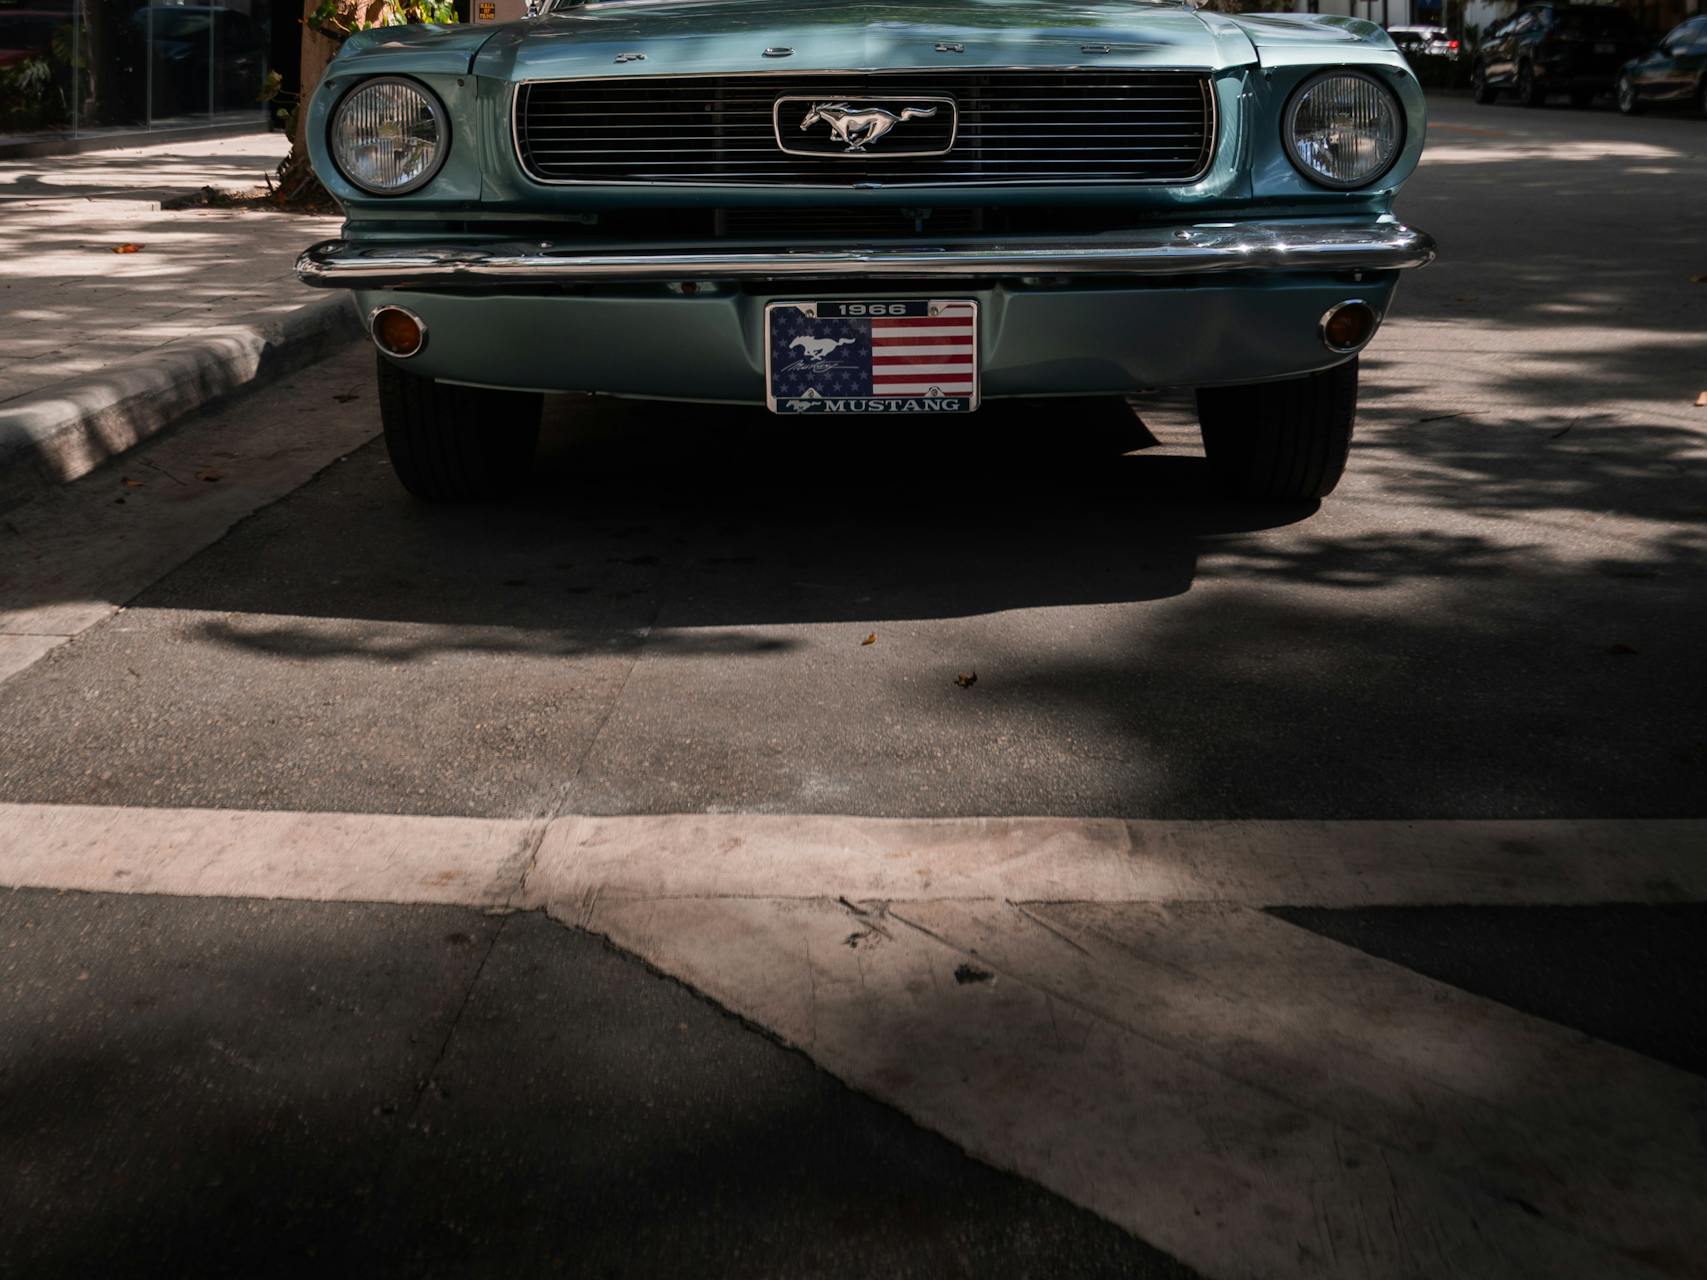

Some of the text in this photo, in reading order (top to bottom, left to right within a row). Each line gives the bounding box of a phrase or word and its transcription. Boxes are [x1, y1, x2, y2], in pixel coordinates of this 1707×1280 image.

[839, 304, 907, 316] 1966
[781, 359, 859, 373] Mustang
[824, 398, 960, 412] MUSTANG
